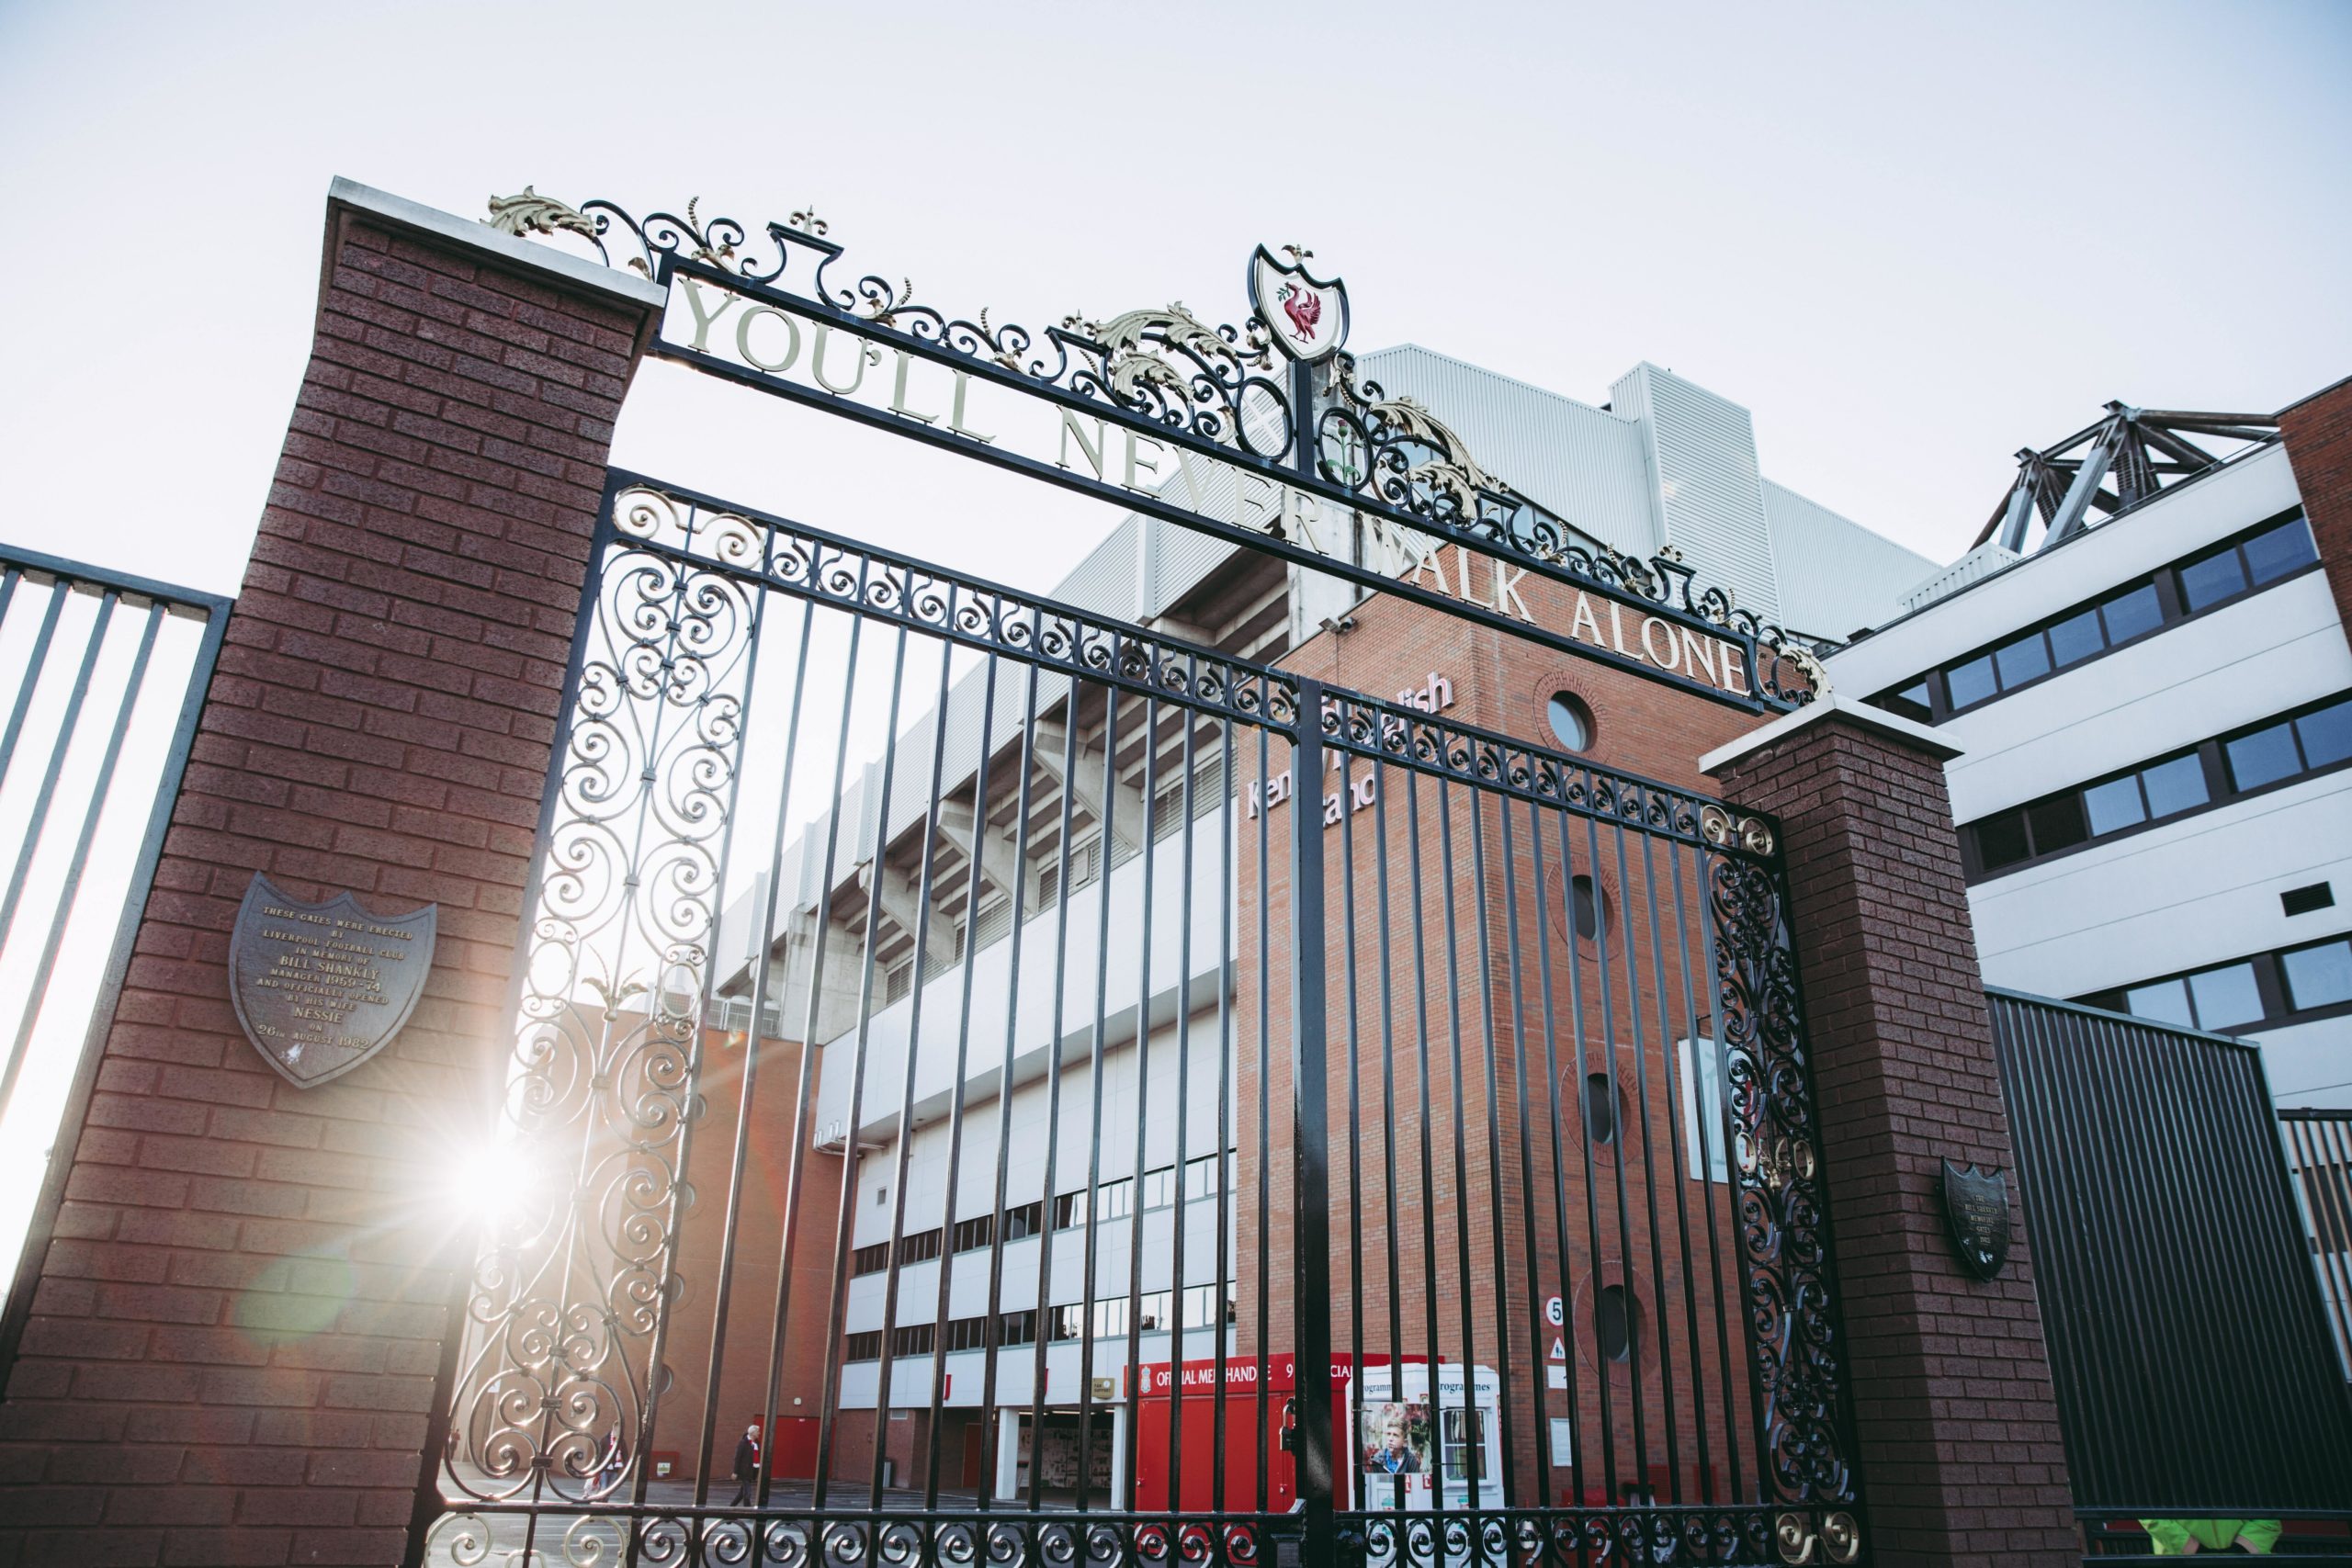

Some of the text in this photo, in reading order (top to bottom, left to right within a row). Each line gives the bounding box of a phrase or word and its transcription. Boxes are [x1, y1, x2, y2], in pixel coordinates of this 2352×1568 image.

[678, 276, 1751, 697] YOU'LL NEVER WALK ALONE
[263, 906, 413, 941] THESE GATES WERE ERECTED
[331, 930, 345, 939] BY
[263, 930, 405, 960] LIVERPOOL FOOTBALL CLUB
[295, 946, 370, 965] IN MEMORY OF
[270, 968, 321, 983] MANAGER
[279, 955, 379, 980] BILL SHANKLY
[256, 977, 390, 1005] AND OFFICIALLY OPENED
[287, 994, 356, 1011] BY HIS WIFE
[294, 1007, 344, 1023] NESSIE
[310, 1023, 322, 1032] ON
[293, 1032, 333, 1044] AUGUST
[337, 1035, 369, 1049] 1982
[1552, 1301, 1562, 1322] 5
[1156, 1369, 1196, 1387] OFIAL
[1440, 1382, 1491, 1394] rogrames
